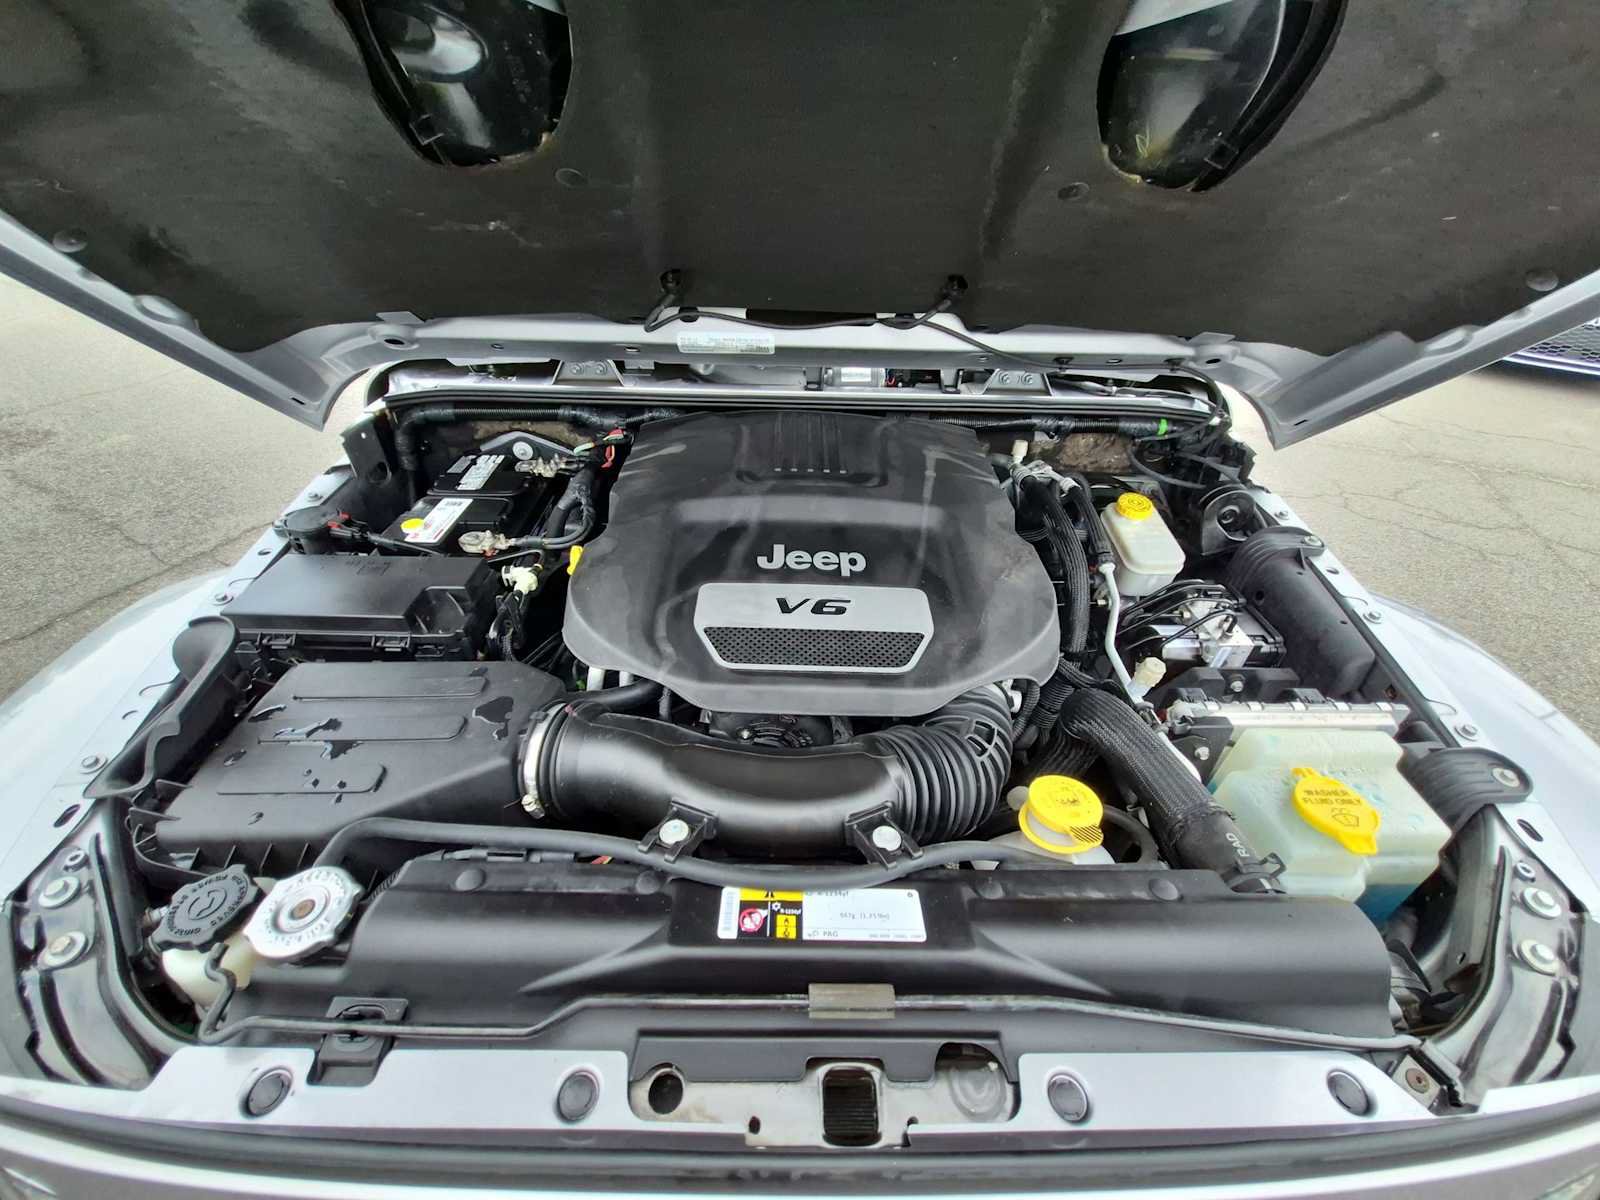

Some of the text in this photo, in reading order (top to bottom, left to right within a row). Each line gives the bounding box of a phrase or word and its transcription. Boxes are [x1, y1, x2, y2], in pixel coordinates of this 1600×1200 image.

[756, 543, 867, 577] Jeep
[775, 596, 852, 616] V6
[1225, 832, 1250, 857] RAD
